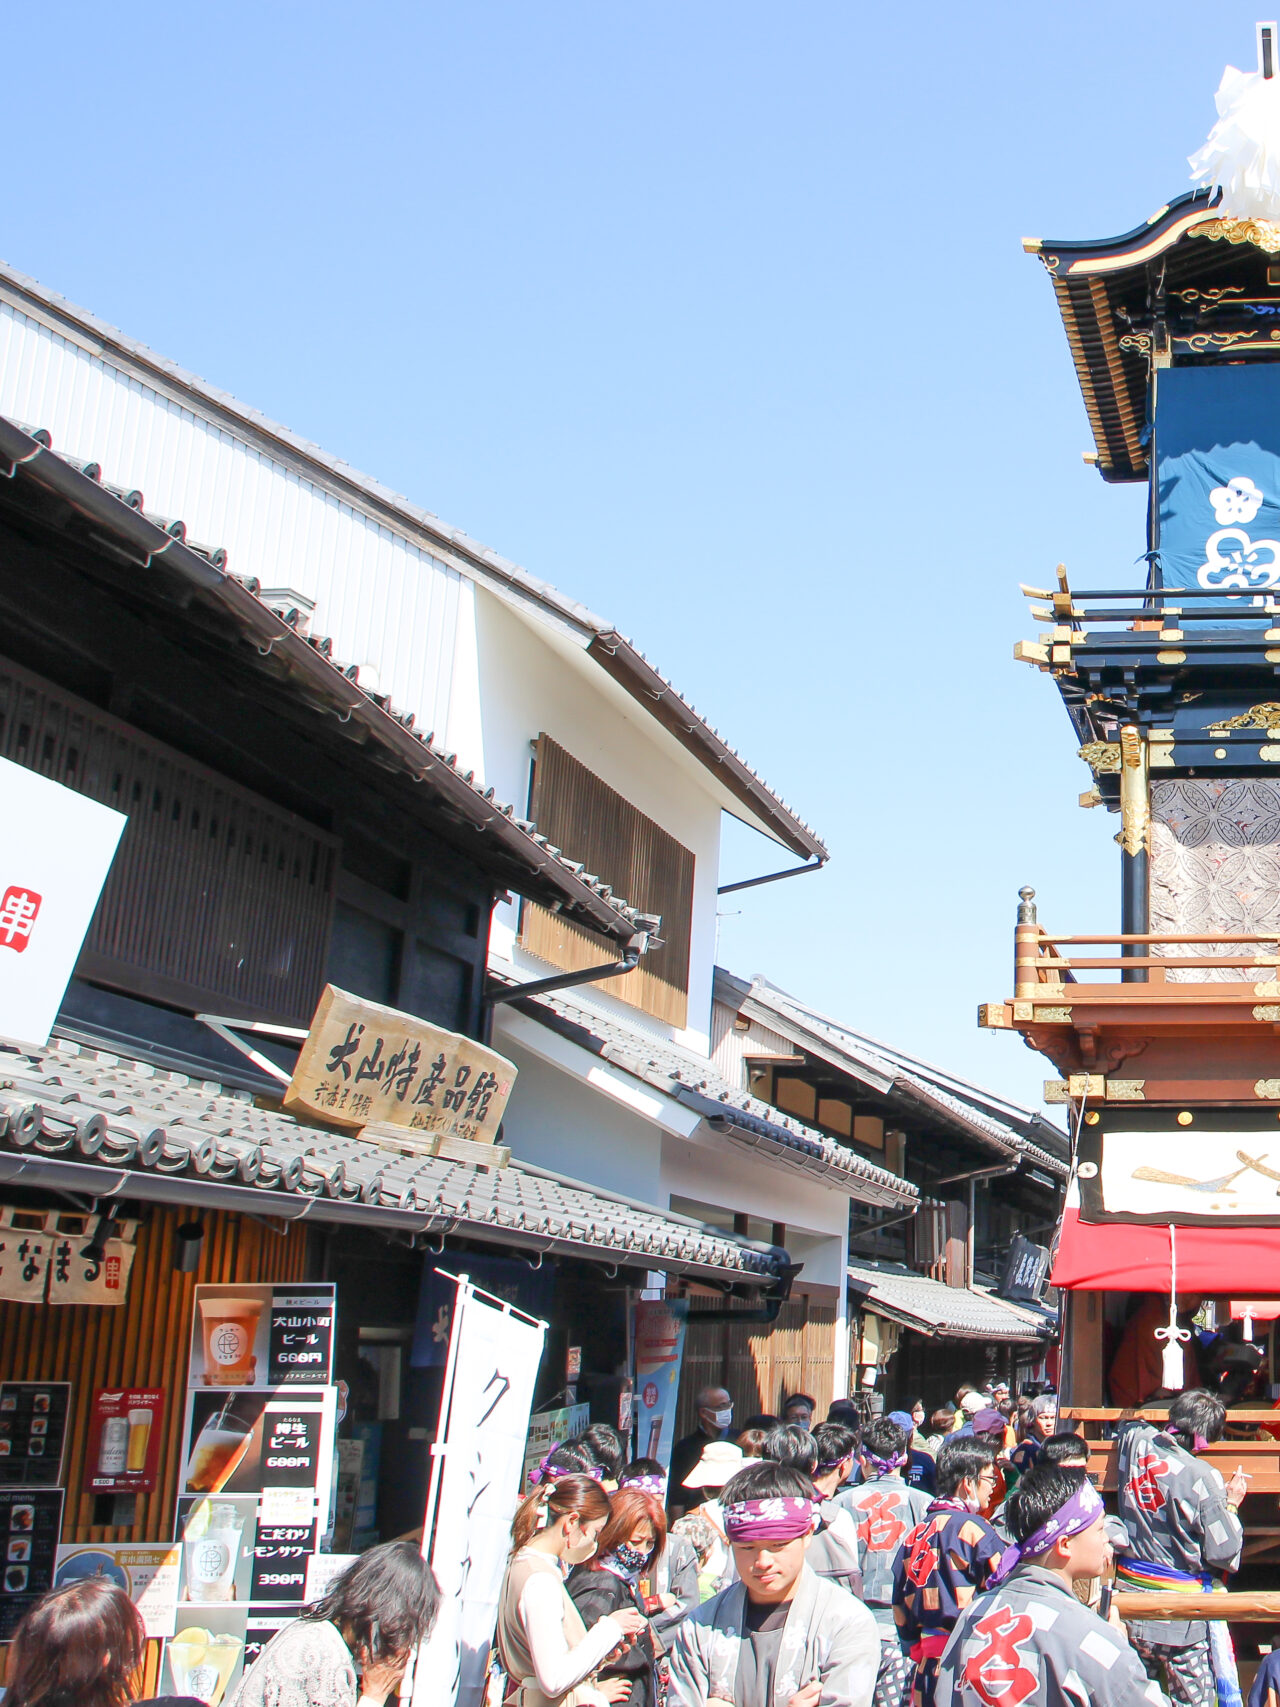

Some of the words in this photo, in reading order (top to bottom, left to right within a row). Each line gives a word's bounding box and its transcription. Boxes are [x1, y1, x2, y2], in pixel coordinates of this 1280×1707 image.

[0, 892, 37, 944] 串
[326, 1022, 499, 1122] 犬山特産品館
[273, 1316, 331, 1328] 犬山小町
[282, 1333, 320, 1345] ビール
[277, 1352, 322, 1364] 600円
[271, 1437, 310, 1449] ビール
[267, 1457, 310, 1467] 600円
[260, 1529, 310, 1540] こだわり
[243, 1547, 314, 1558] レモンサワー
